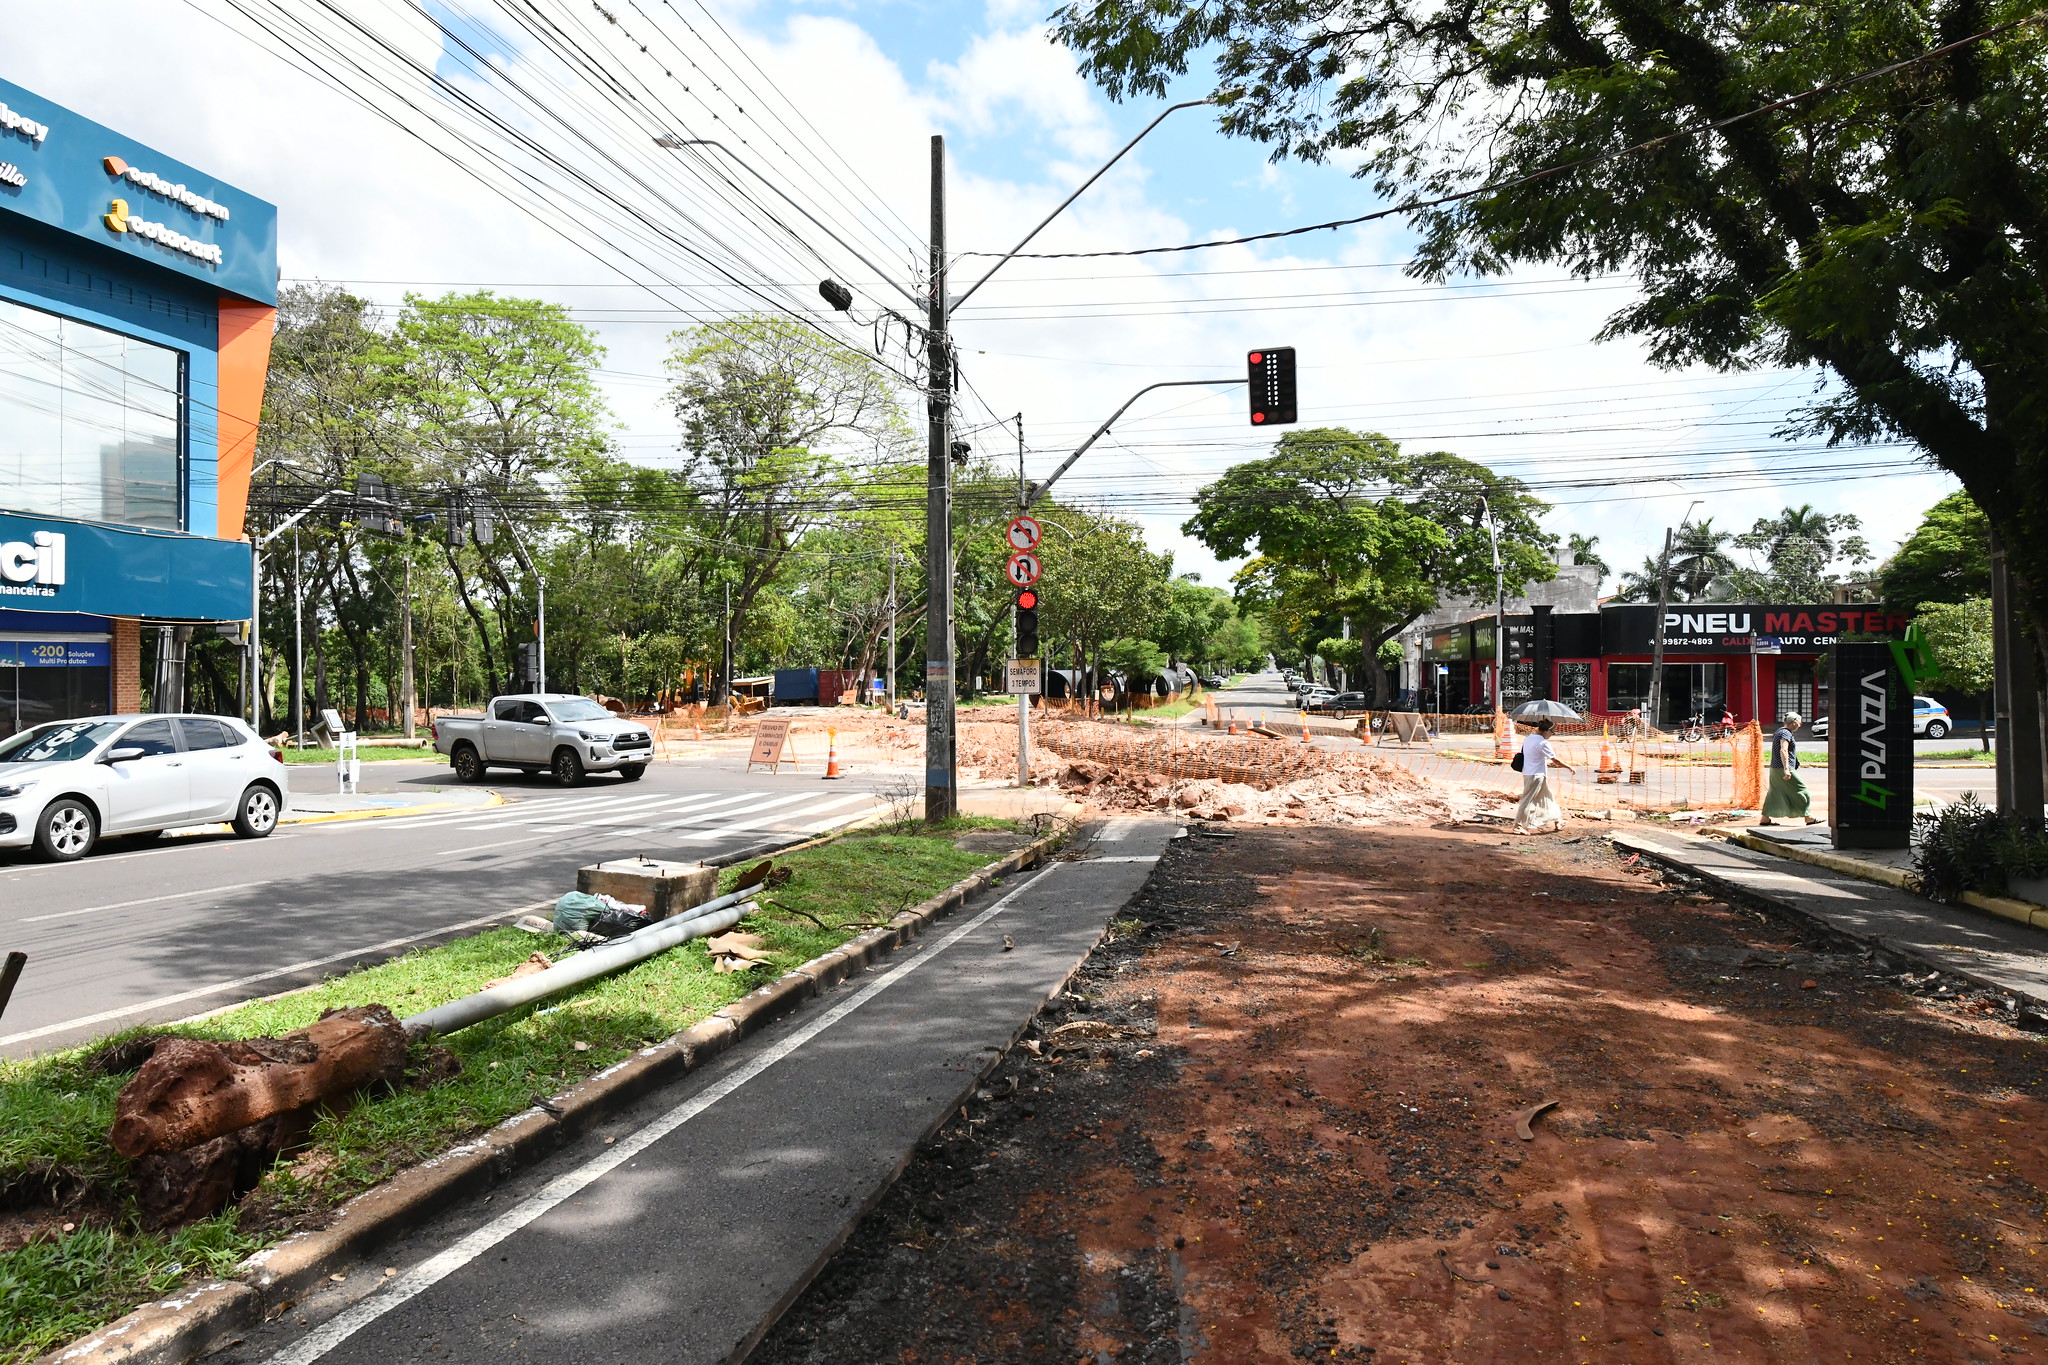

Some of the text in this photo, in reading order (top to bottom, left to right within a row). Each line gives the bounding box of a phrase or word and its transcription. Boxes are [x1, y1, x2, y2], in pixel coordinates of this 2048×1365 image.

[0, 102, 49, 142] lpay
[0, 530, 66, 585] cil
[1663, 612, 1907, 633] PNEU MASTER
[1778, 636, 1806, 645] AUTO
[32, 645, 65, 657] +200
[1889, 666, 1897, 710] ENERGIA
[1861, 669, 1886, 779] PLAZZA
